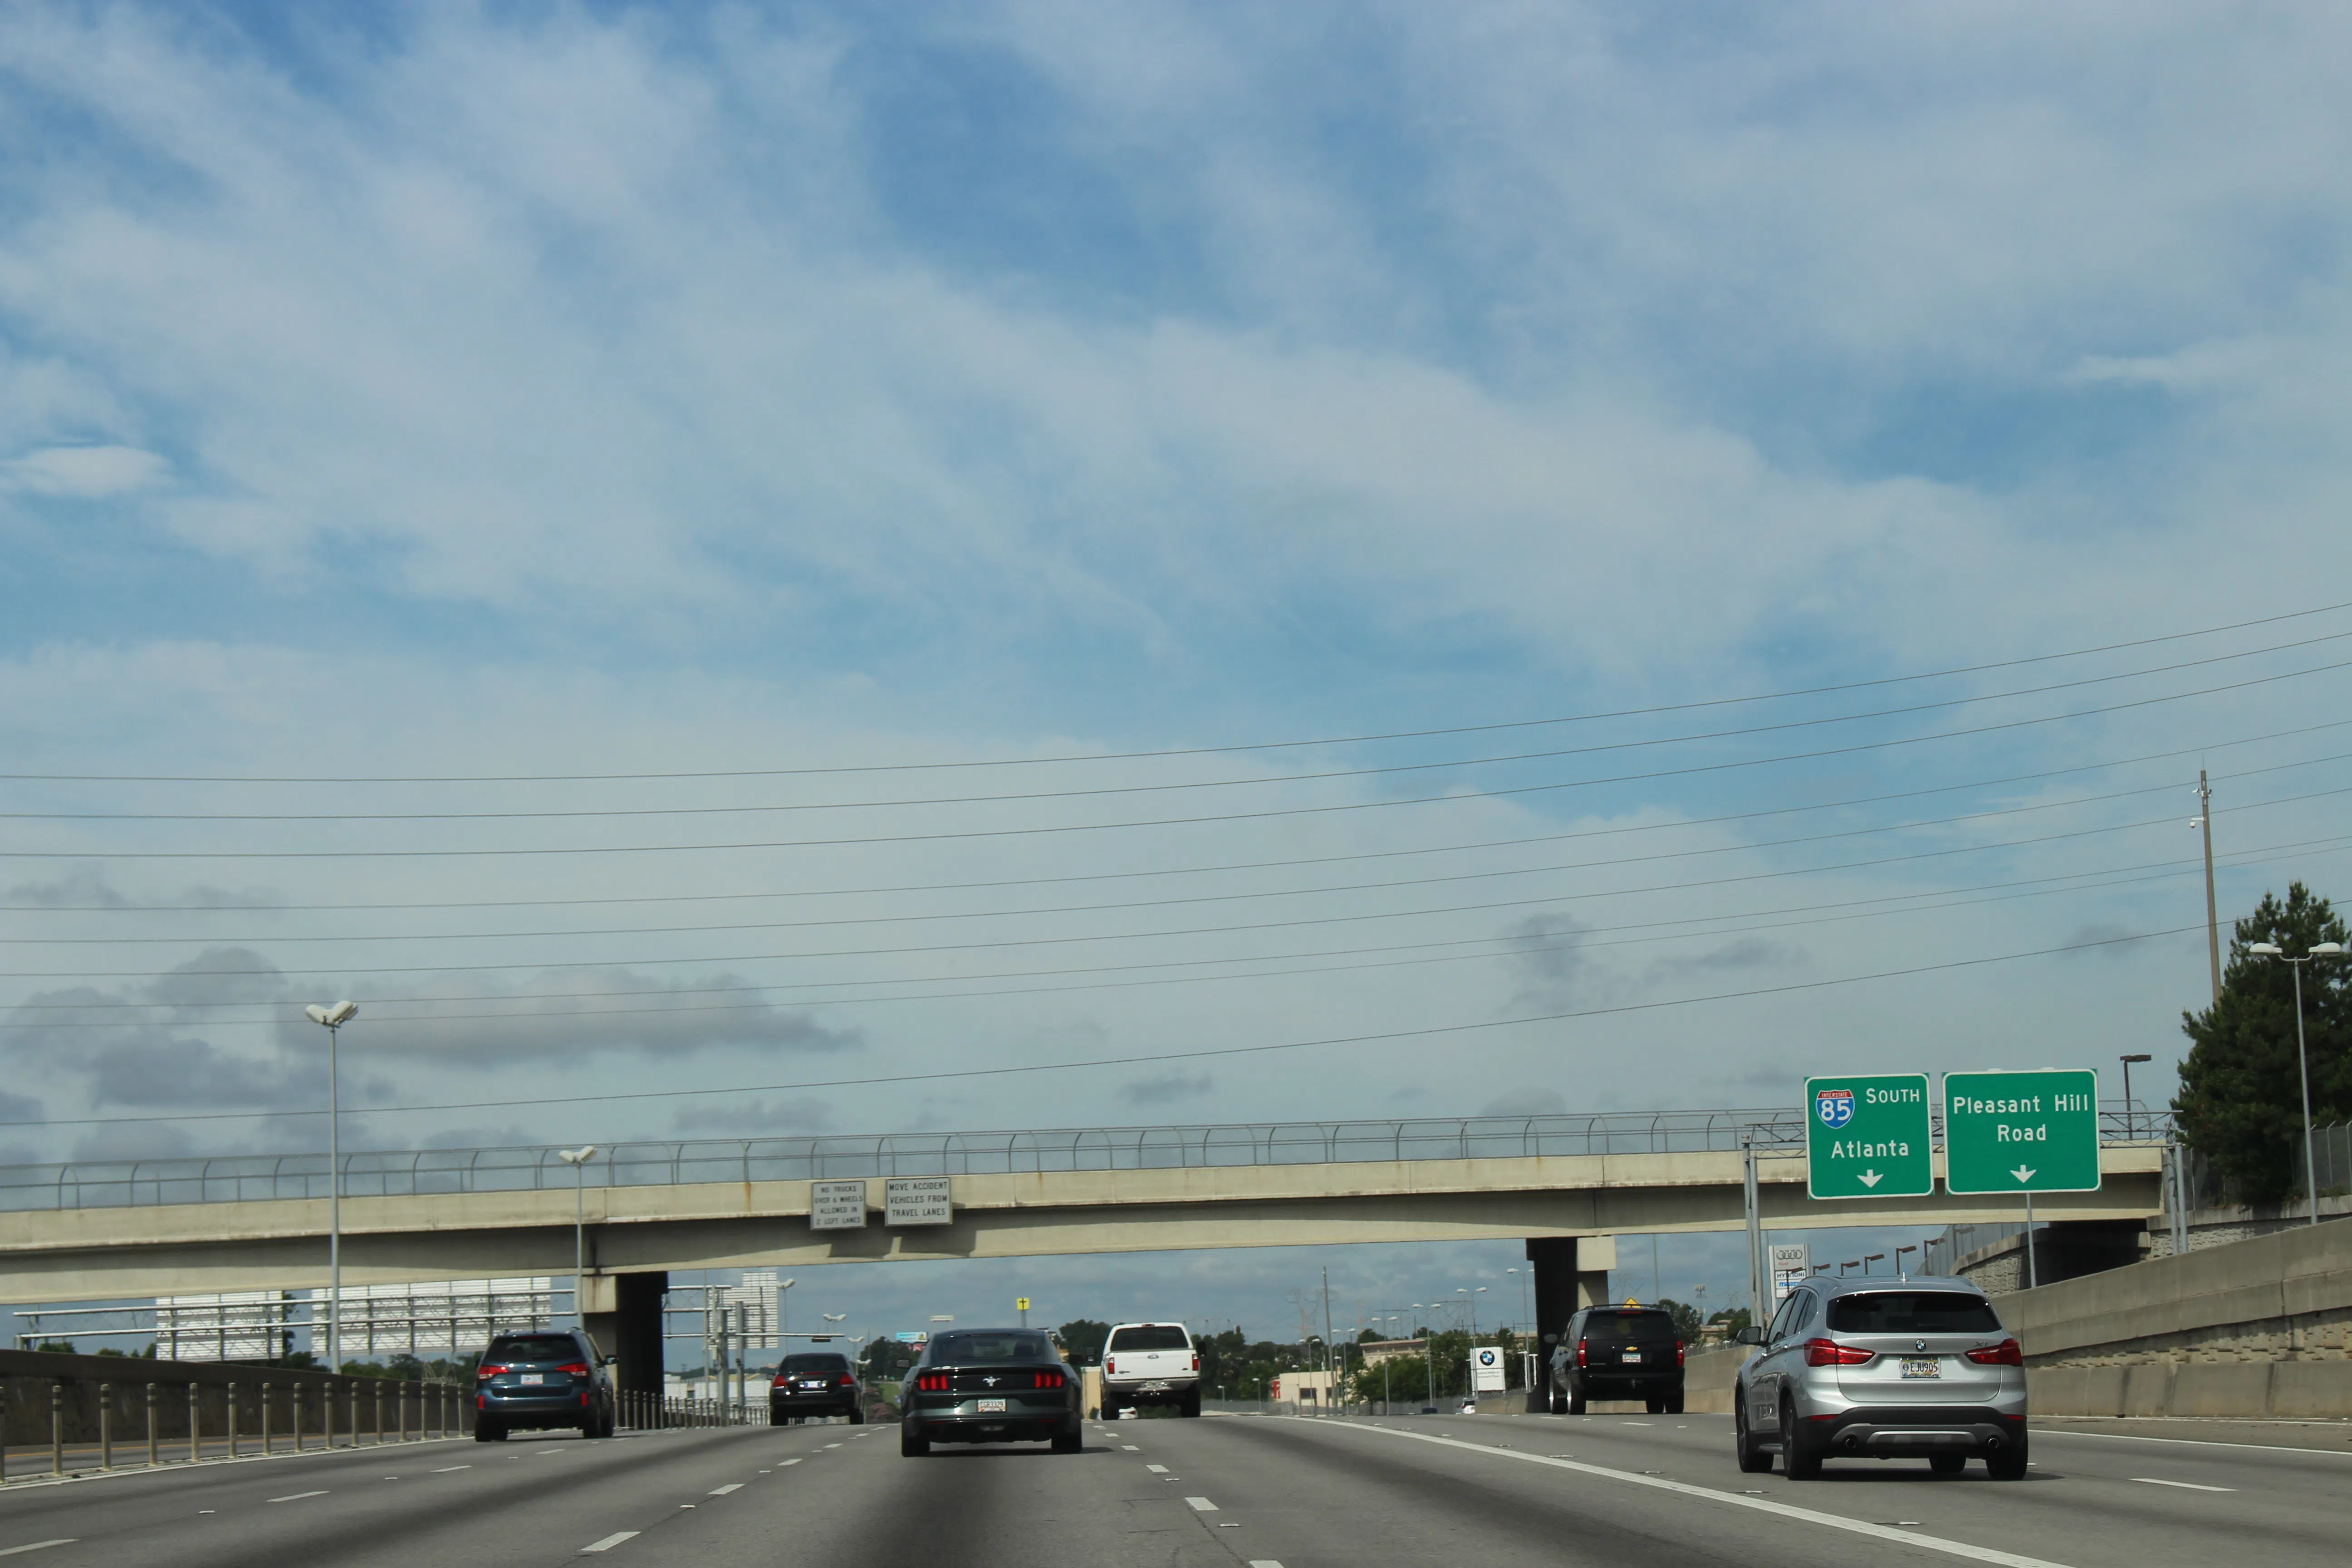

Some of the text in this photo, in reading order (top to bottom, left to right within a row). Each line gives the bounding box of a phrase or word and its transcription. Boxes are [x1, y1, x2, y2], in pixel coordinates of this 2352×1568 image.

[1866, 1088, 1920, 1104] SOUTH
[1953, 1093, 2088, 1114] Pleasant Hill
[1821, 1099, 1851, 1121] 85
[1997, 1123, 2047, 1142] Road
[1831, 1139, 1909, 1159] Atlanta
[889, 1181, 947, 1191] MOVE ACCIDENT
[890, 1195, 948, 1204] VEHICLES FROM
[923, 1208, 946, 1216] LANES
[1910, 1362, 1938, 1372] EJU905
